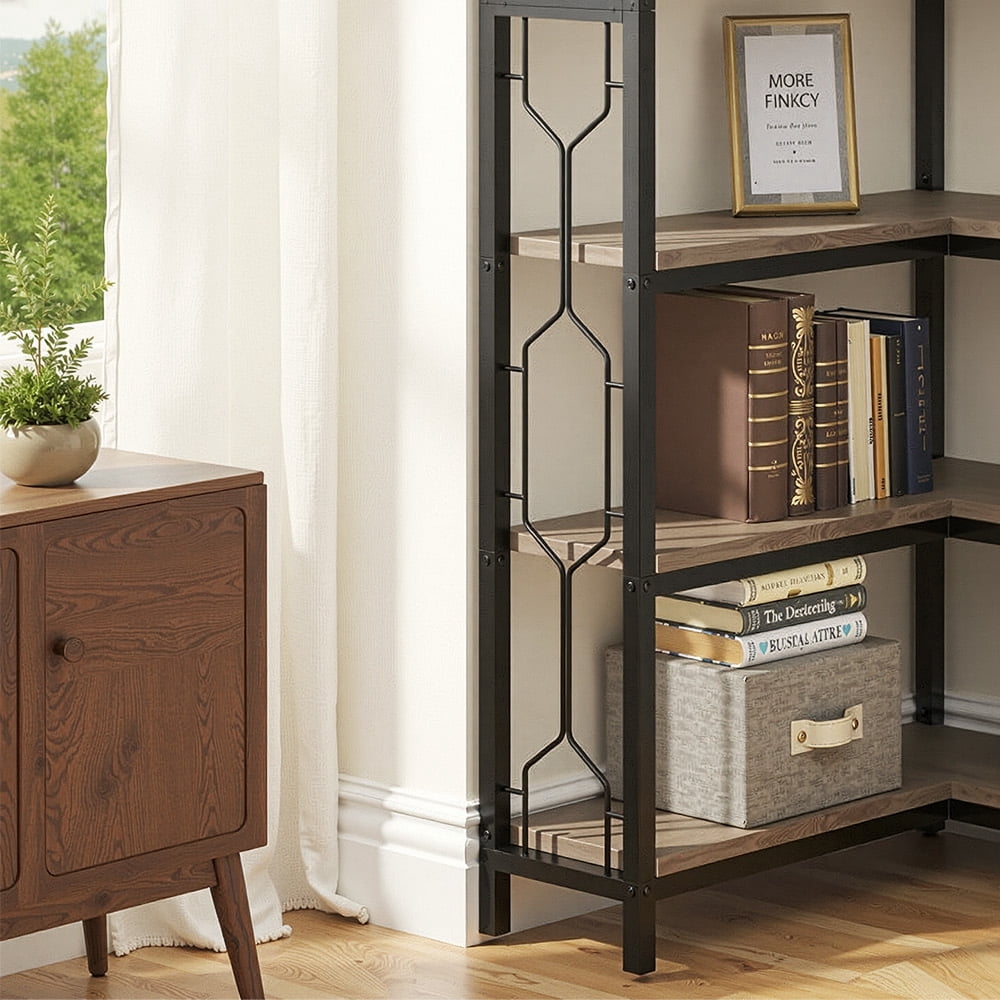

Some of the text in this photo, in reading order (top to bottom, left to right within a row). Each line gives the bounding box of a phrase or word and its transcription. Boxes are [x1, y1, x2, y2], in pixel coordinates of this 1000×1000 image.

[769, 73, 814, 88] MORE
[765, 92, 819, 109] FINKCY
[764, 609, 783, 624] The
